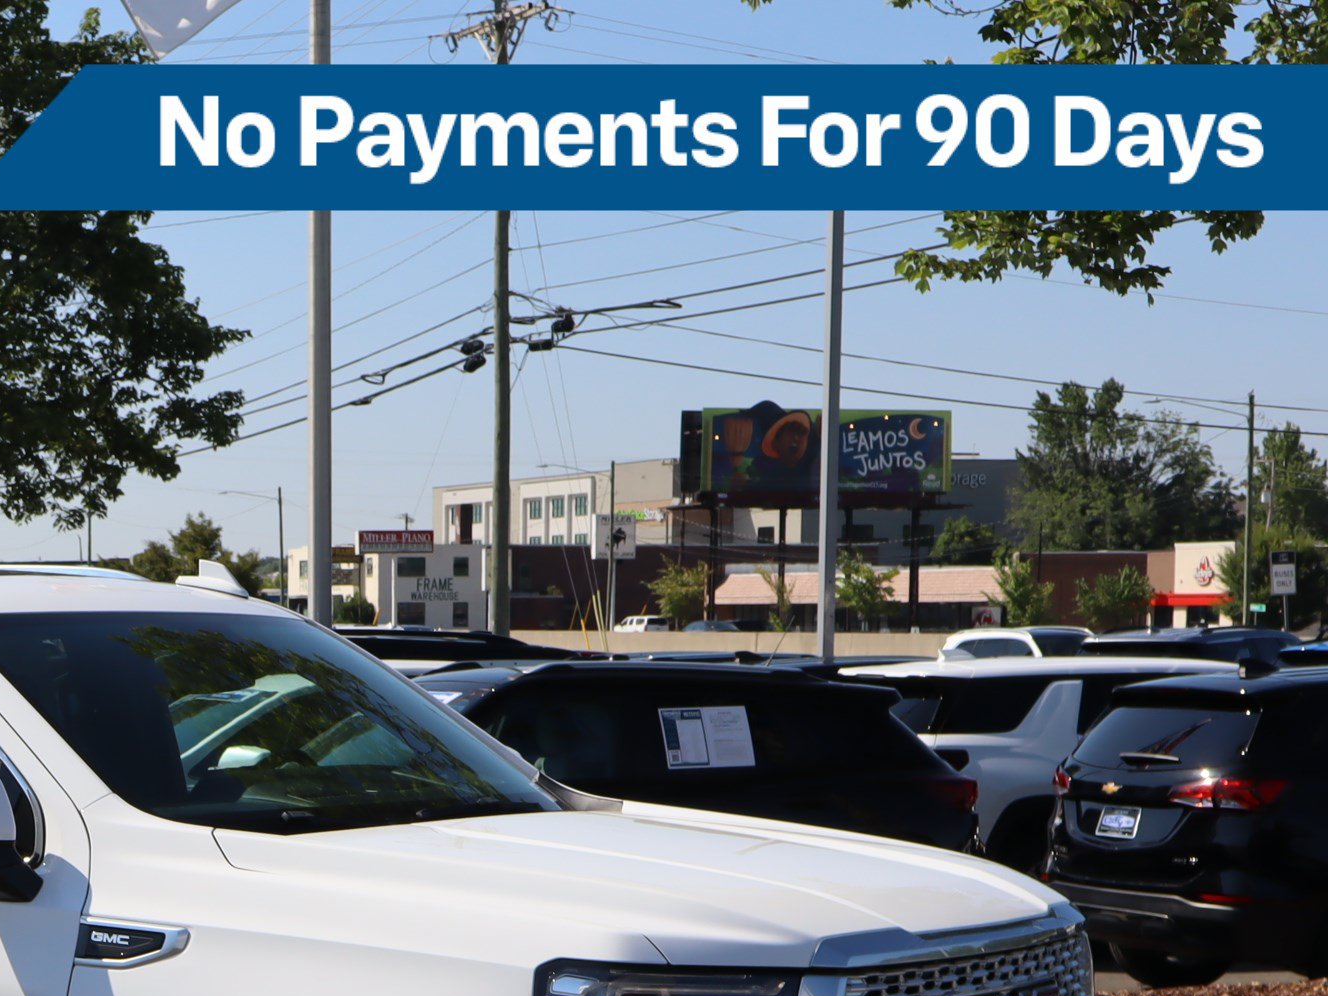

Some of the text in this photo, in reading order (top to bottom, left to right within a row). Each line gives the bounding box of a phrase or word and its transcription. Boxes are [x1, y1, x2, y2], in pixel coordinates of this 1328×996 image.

[842, 428, 910, 453] LEAMOS
[853, 451, 926, 478] JUNTOS
[362, 532, 431, 543] MILLER PIANO
[1274, 570, 1294, 578] BUSES
[416, 577, 454, 592] FRAME
[410, 591, 459, 601] WAREHOUSE
[91, 930, 130, 945] GMC
